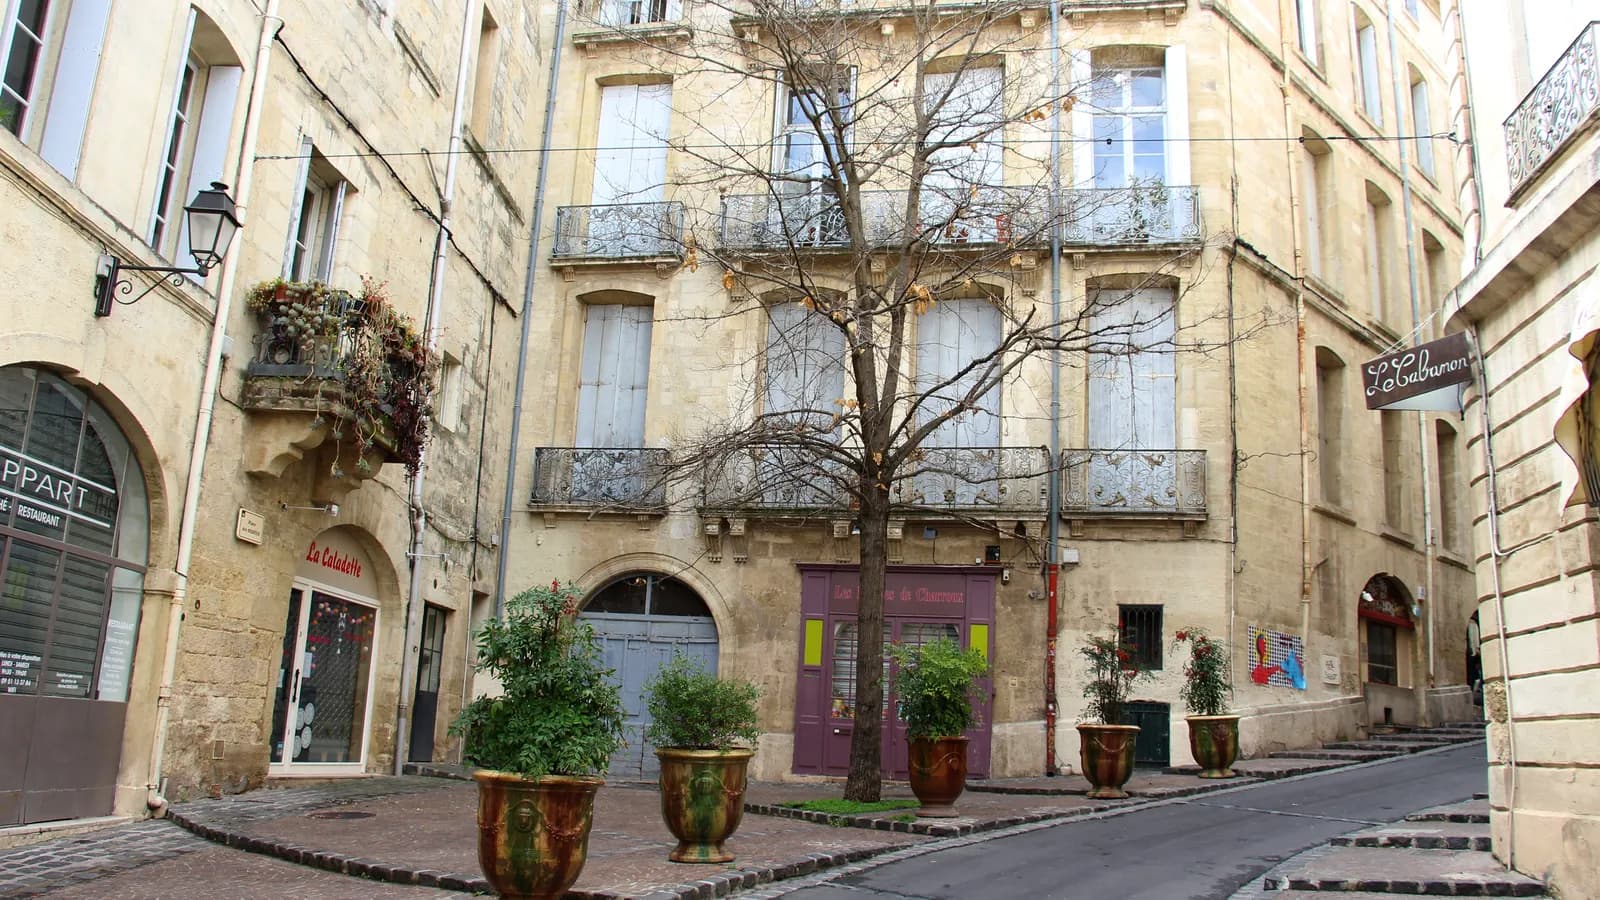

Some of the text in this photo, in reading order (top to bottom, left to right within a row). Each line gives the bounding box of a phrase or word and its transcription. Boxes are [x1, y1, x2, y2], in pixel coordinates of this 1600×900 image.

[1366, 349, 1468, 396] Le Cabanon
[17, 504, 60, 527] RESTAURANT
[306, 541, 361, 578] La Caladette
